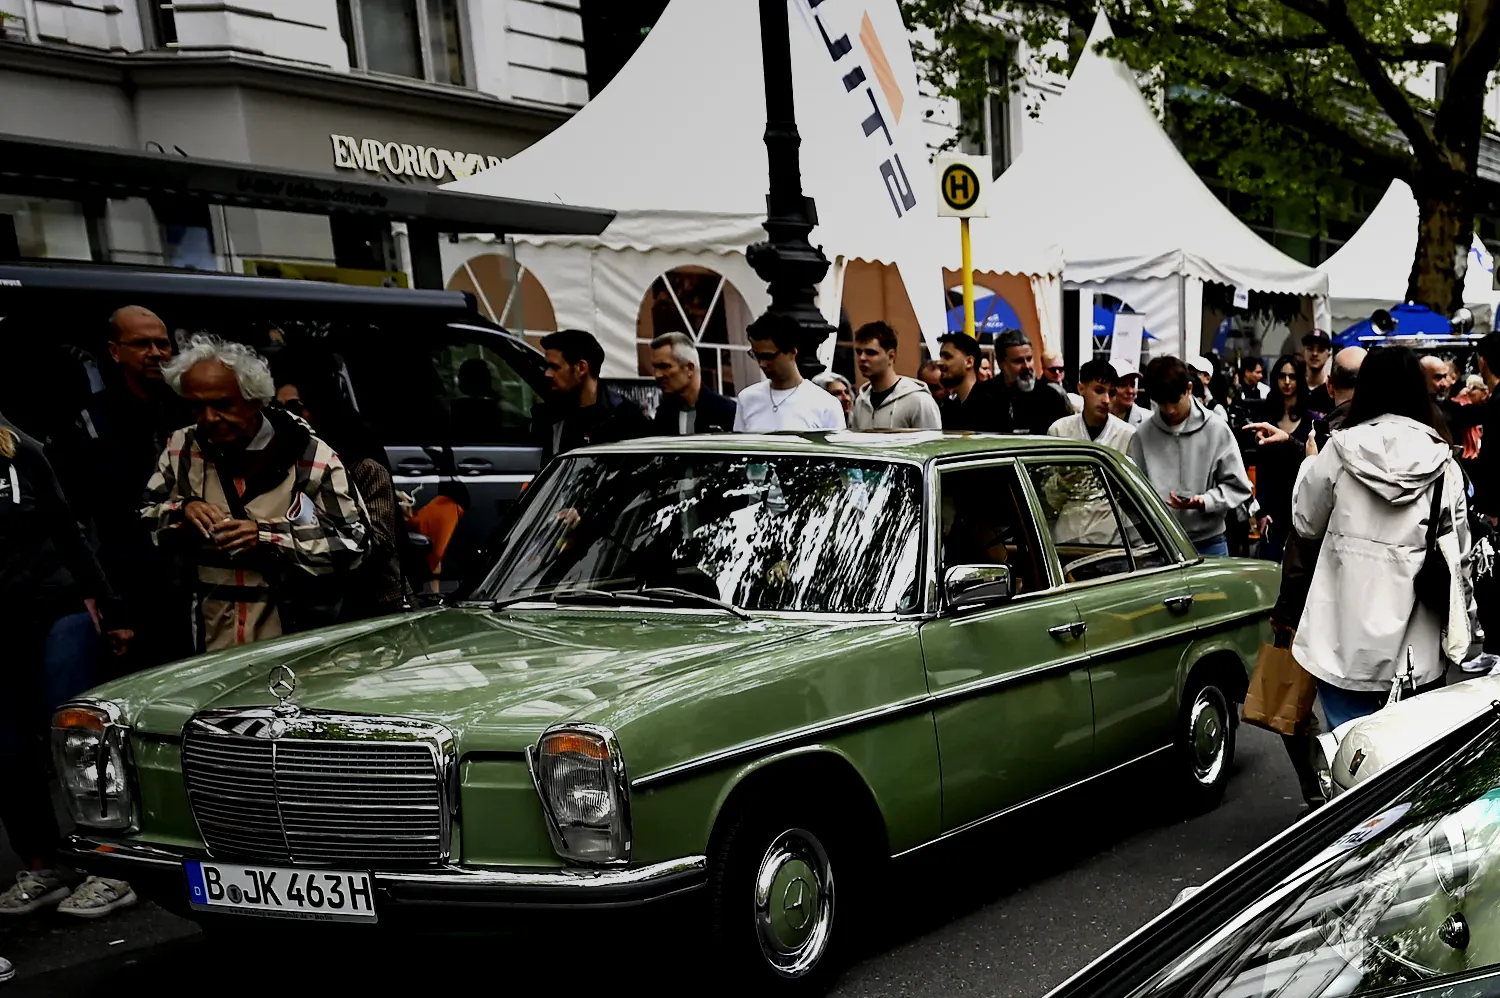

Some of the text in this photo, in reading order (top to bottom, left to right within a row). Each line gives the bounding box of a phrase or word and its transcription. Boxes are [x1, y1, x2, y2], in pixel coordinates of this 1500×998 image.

[331, 133, 446, 180] EMPORIO
[950, 174, 969, 200] H
[194, 866, 373, 911] D B JK 463H
